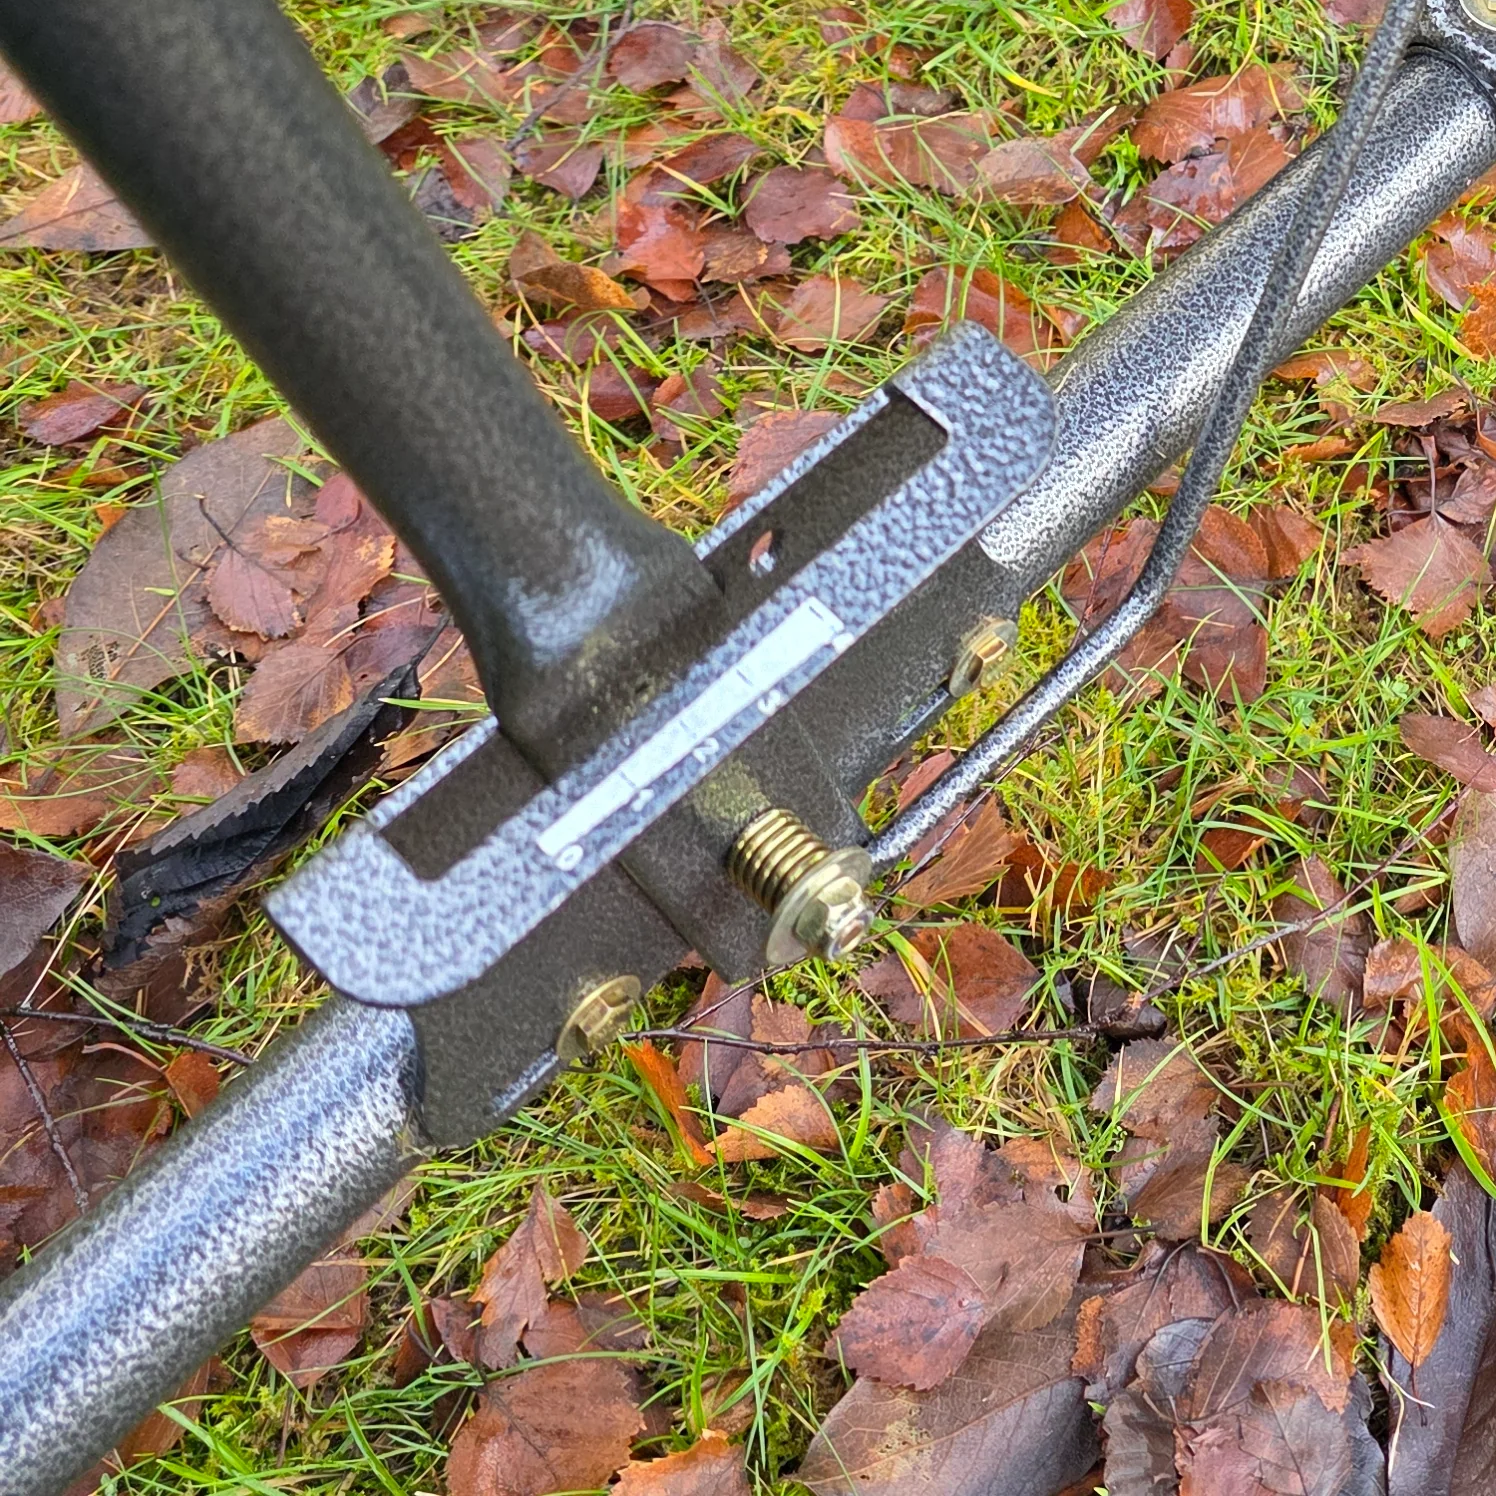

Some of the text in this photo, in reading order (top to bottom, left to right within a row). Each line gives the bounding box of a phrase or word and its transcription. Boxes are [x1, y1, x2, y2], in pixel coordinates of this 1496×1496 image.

[555, 845, 584, 871] 0
[693, 736, 720, 763] 2
[757, 689, 781, 715] 3
